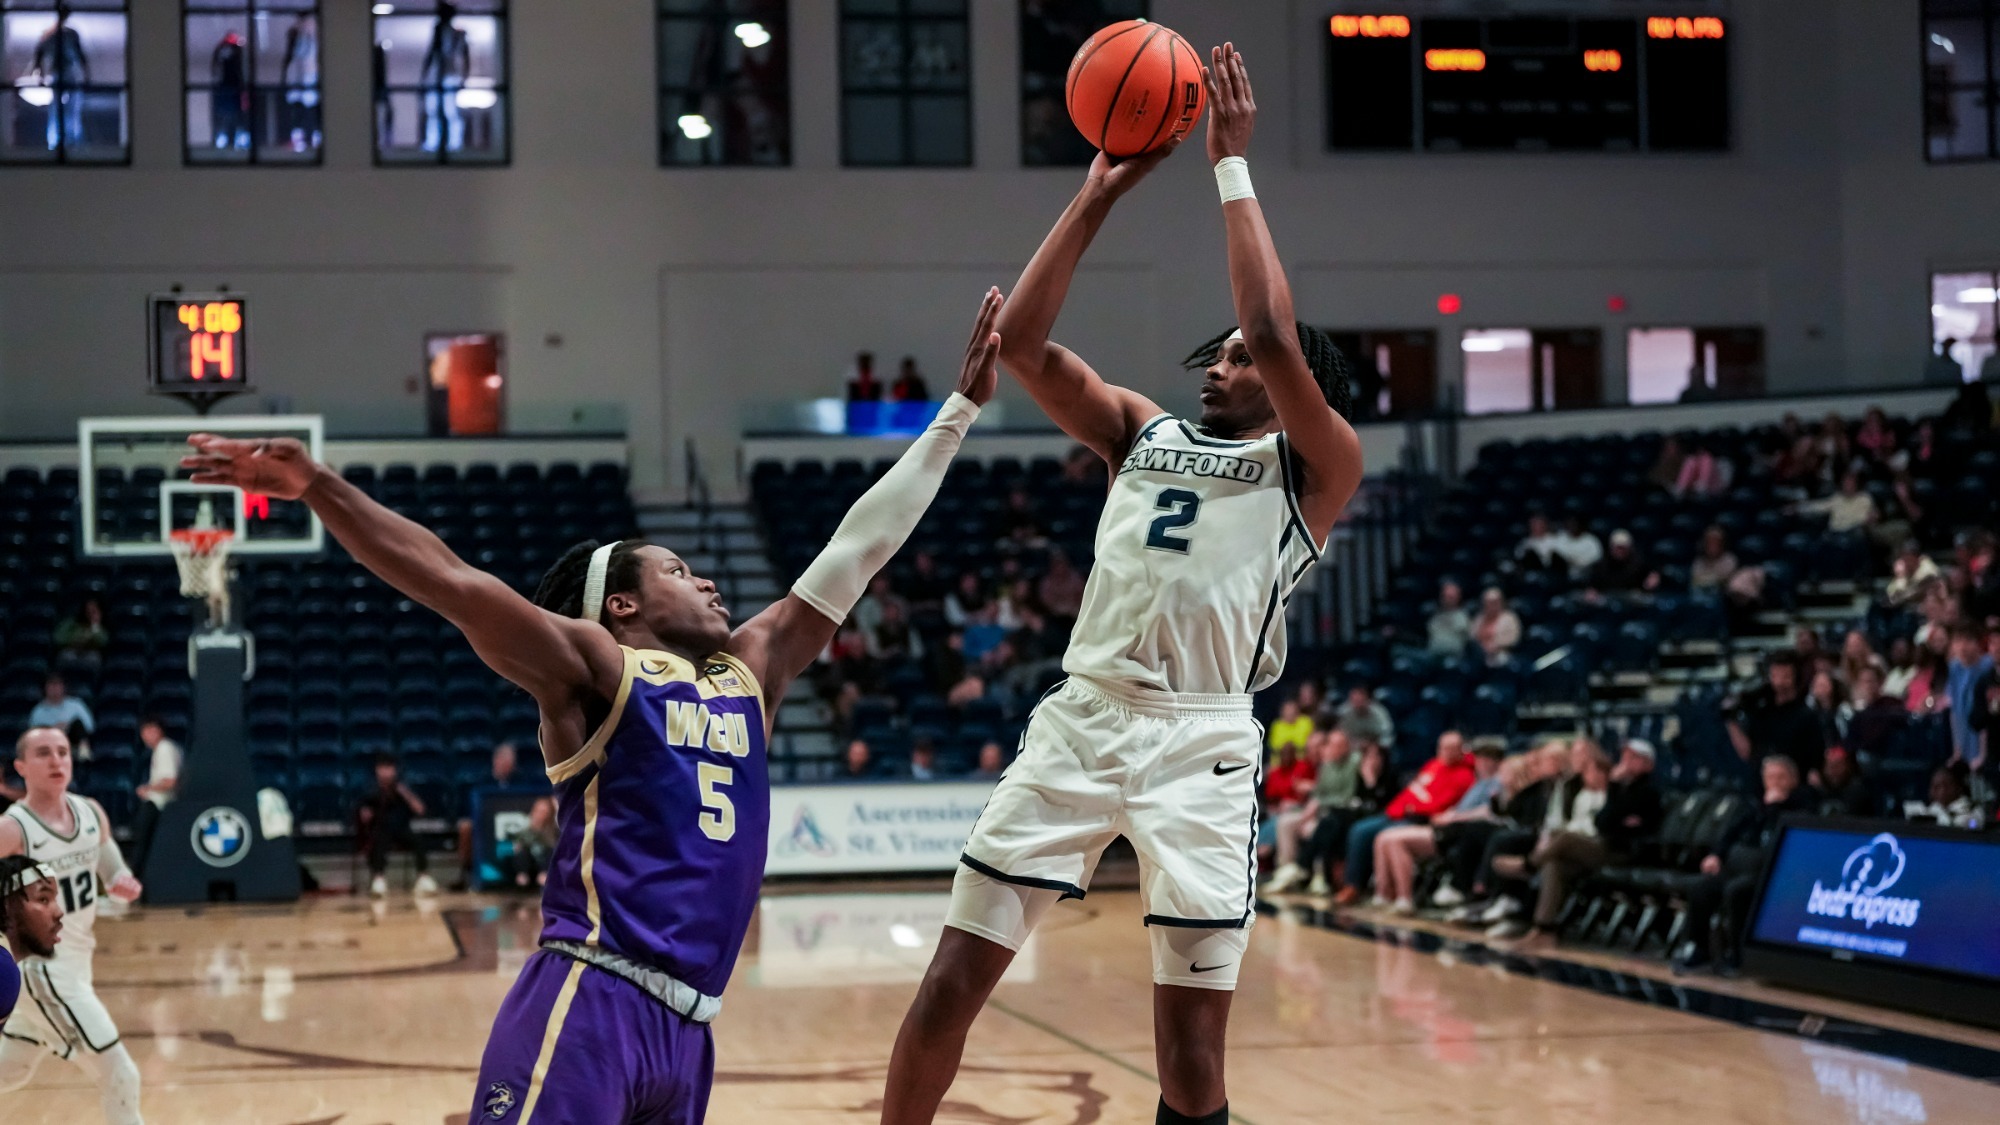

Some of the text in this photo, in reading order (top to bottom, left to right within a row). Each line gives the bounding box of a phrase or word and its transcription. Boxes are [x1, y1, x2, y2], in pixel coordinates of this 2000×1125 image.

[1170, 82, 1199, 138] ELIT
[178, 303, 241, 333] 4:06
[191, 332, 234, 379] 14
[1118, 448, 1264, 484] SAMFORD
[1143, 488, 1203, 555] 2
[666, 700, 750, 758] WCU
[697, 761, 736, 842] 5
[59, 869, 94, 914] 12
